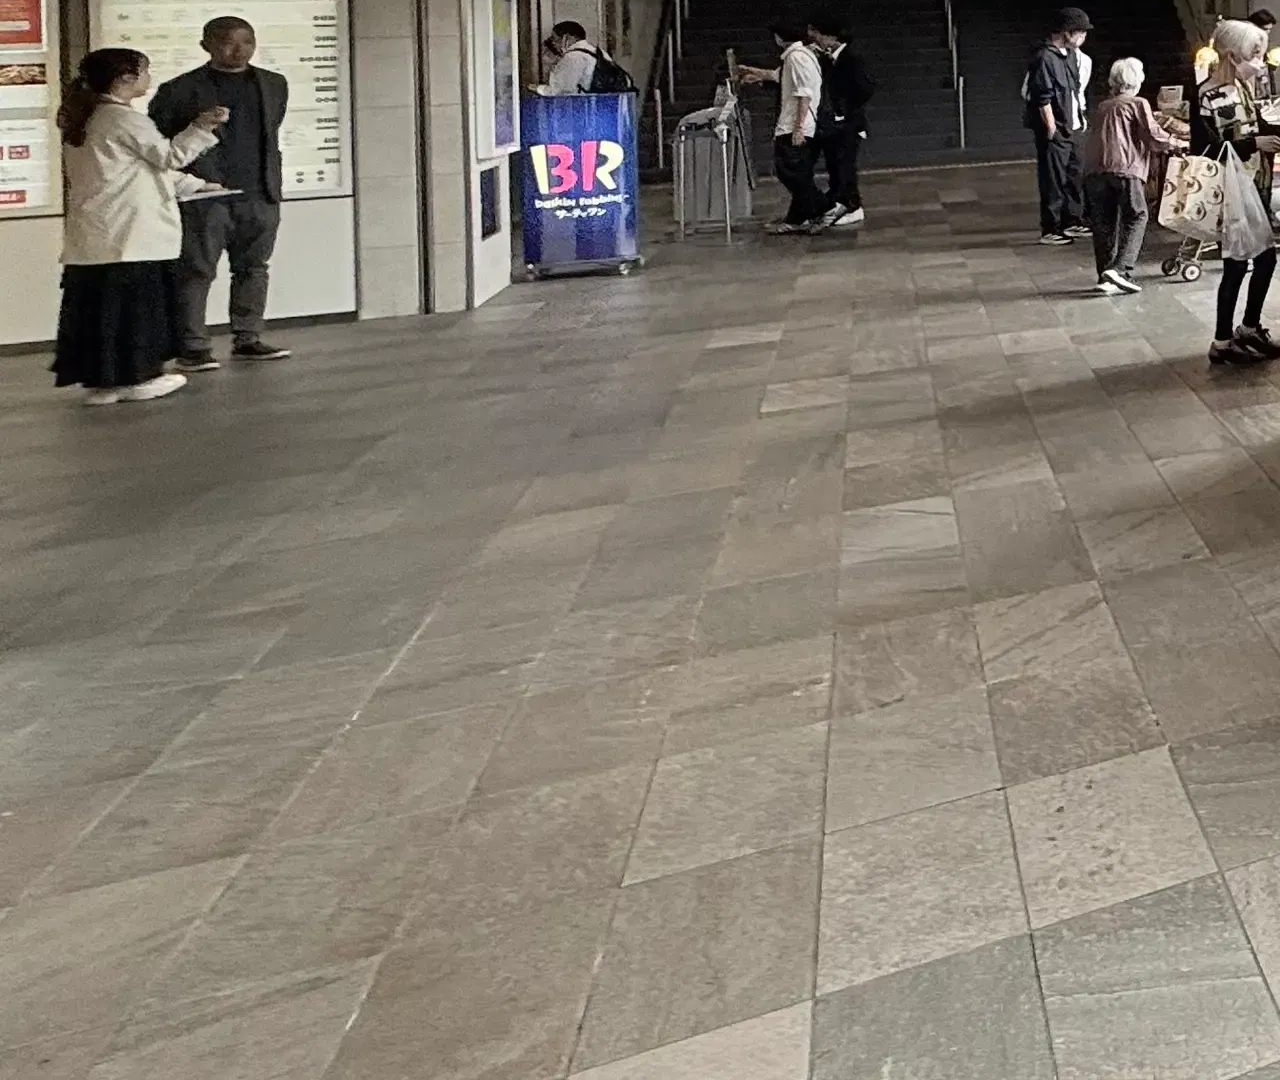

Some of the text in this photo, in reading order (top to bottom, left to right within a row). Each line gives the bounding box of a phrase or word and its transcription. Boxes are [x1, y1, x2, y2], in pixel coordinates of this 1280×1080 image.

[529, 140, 624, 194] BR
[555, 207, 607, 219] サーティワン
